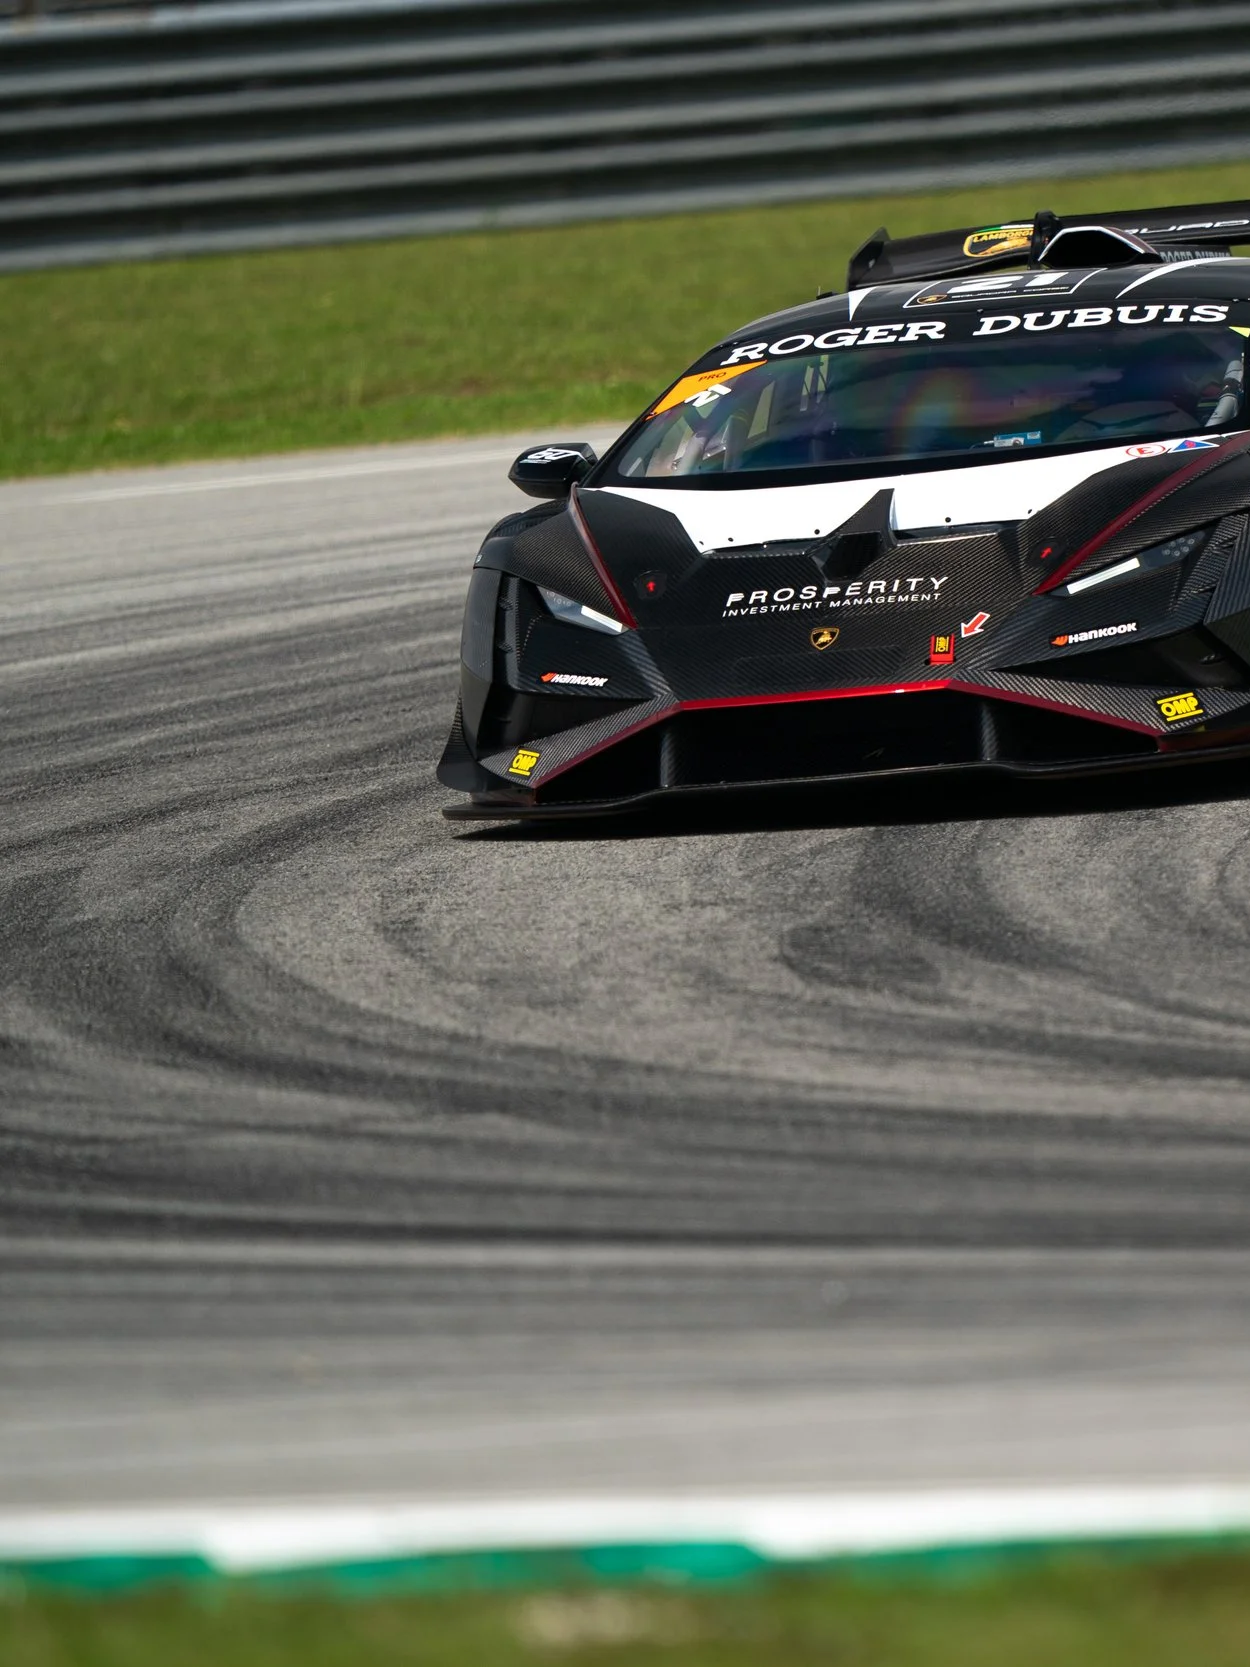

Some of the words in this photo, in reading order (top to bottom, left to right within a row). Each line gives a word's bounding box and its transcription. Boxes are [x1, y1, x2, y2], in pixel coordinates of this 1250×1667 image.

[947, 272, 1069, 294] 21
[720, 321, 946, 366] ROGER
[973, 304, 1230, 336] DUBUIS
[698, 372, 727, 382] PRO
[684, 383, 732, 408] 21
[726, 576, 949, 607] PROSPERITY
[722, 600, 823, 618] INVESTMENT
[829, 592, 942, 609] MANAGEMENT
[1160, 695, 1199, 718] OMP
[512, 753, 538, 772] OMP
